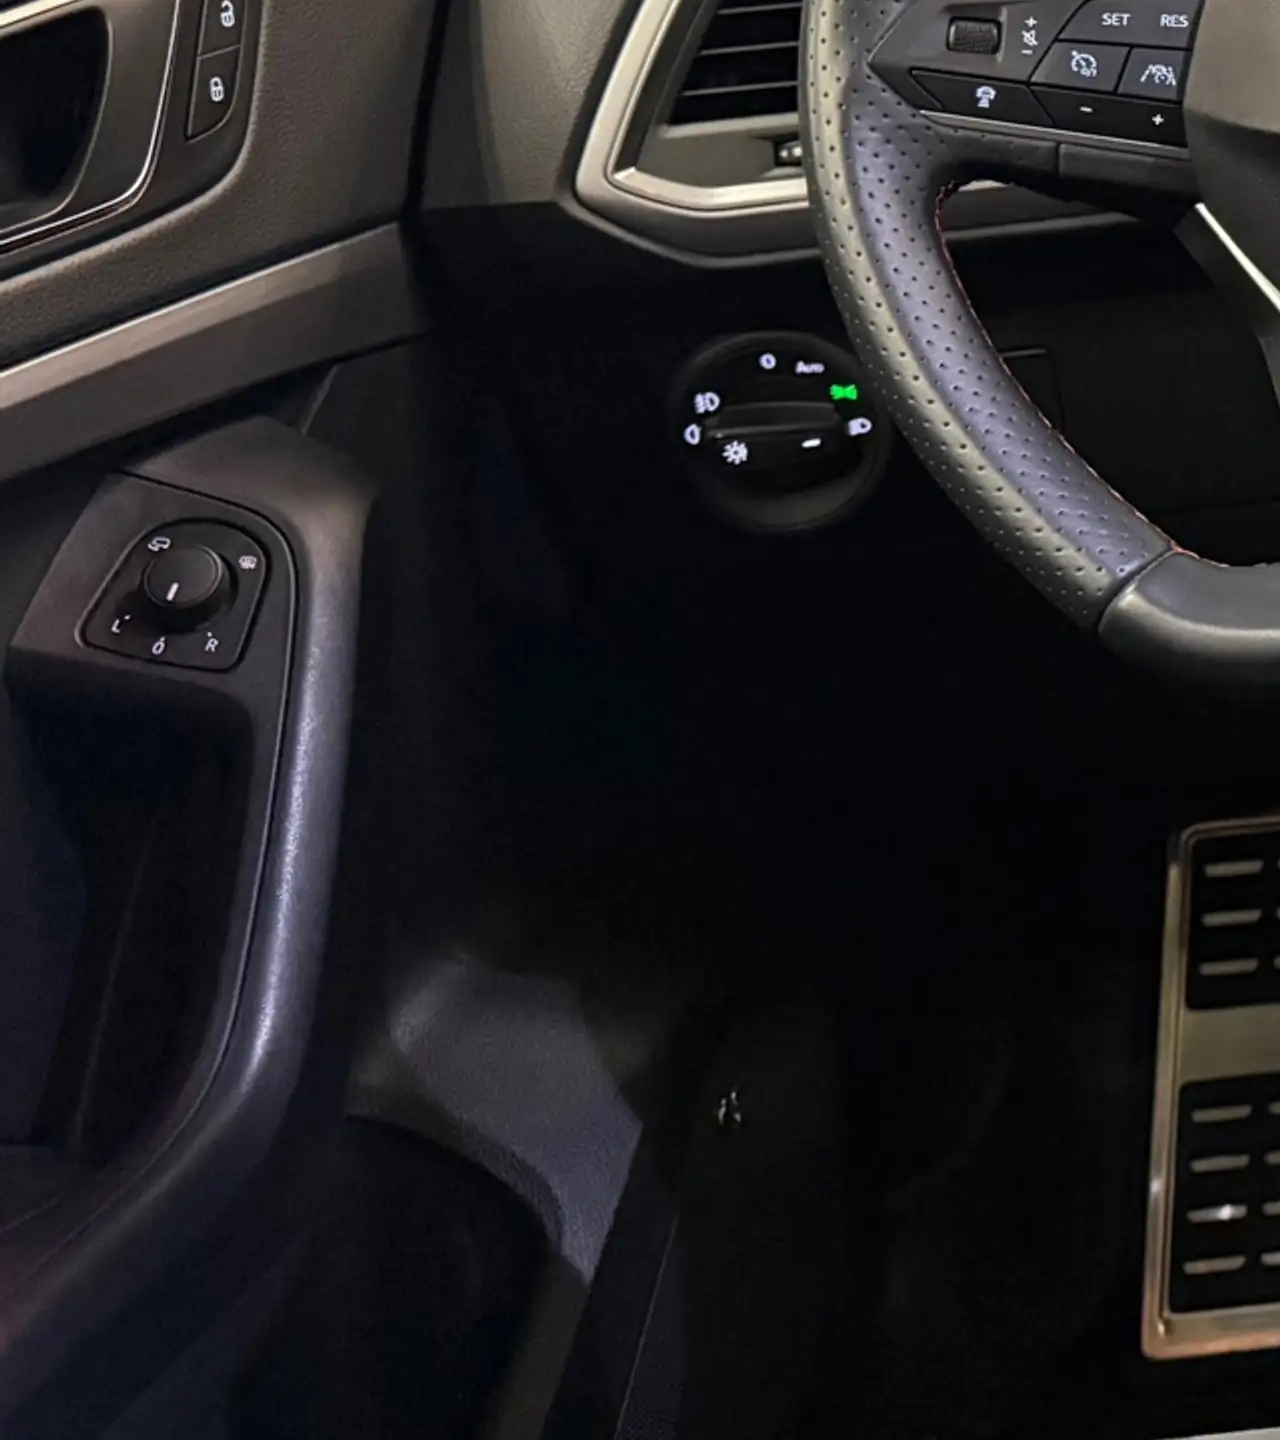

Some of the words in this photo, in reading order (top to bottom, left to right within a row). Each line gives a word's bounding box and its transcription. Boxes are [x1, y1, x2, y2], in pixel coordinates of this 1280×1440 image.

[1101, 12, 1130, 27] SET
[1159, 13, 1190, 29] RES
[110, 618, 122, 635] L
[203, 637, 219, 653] R
